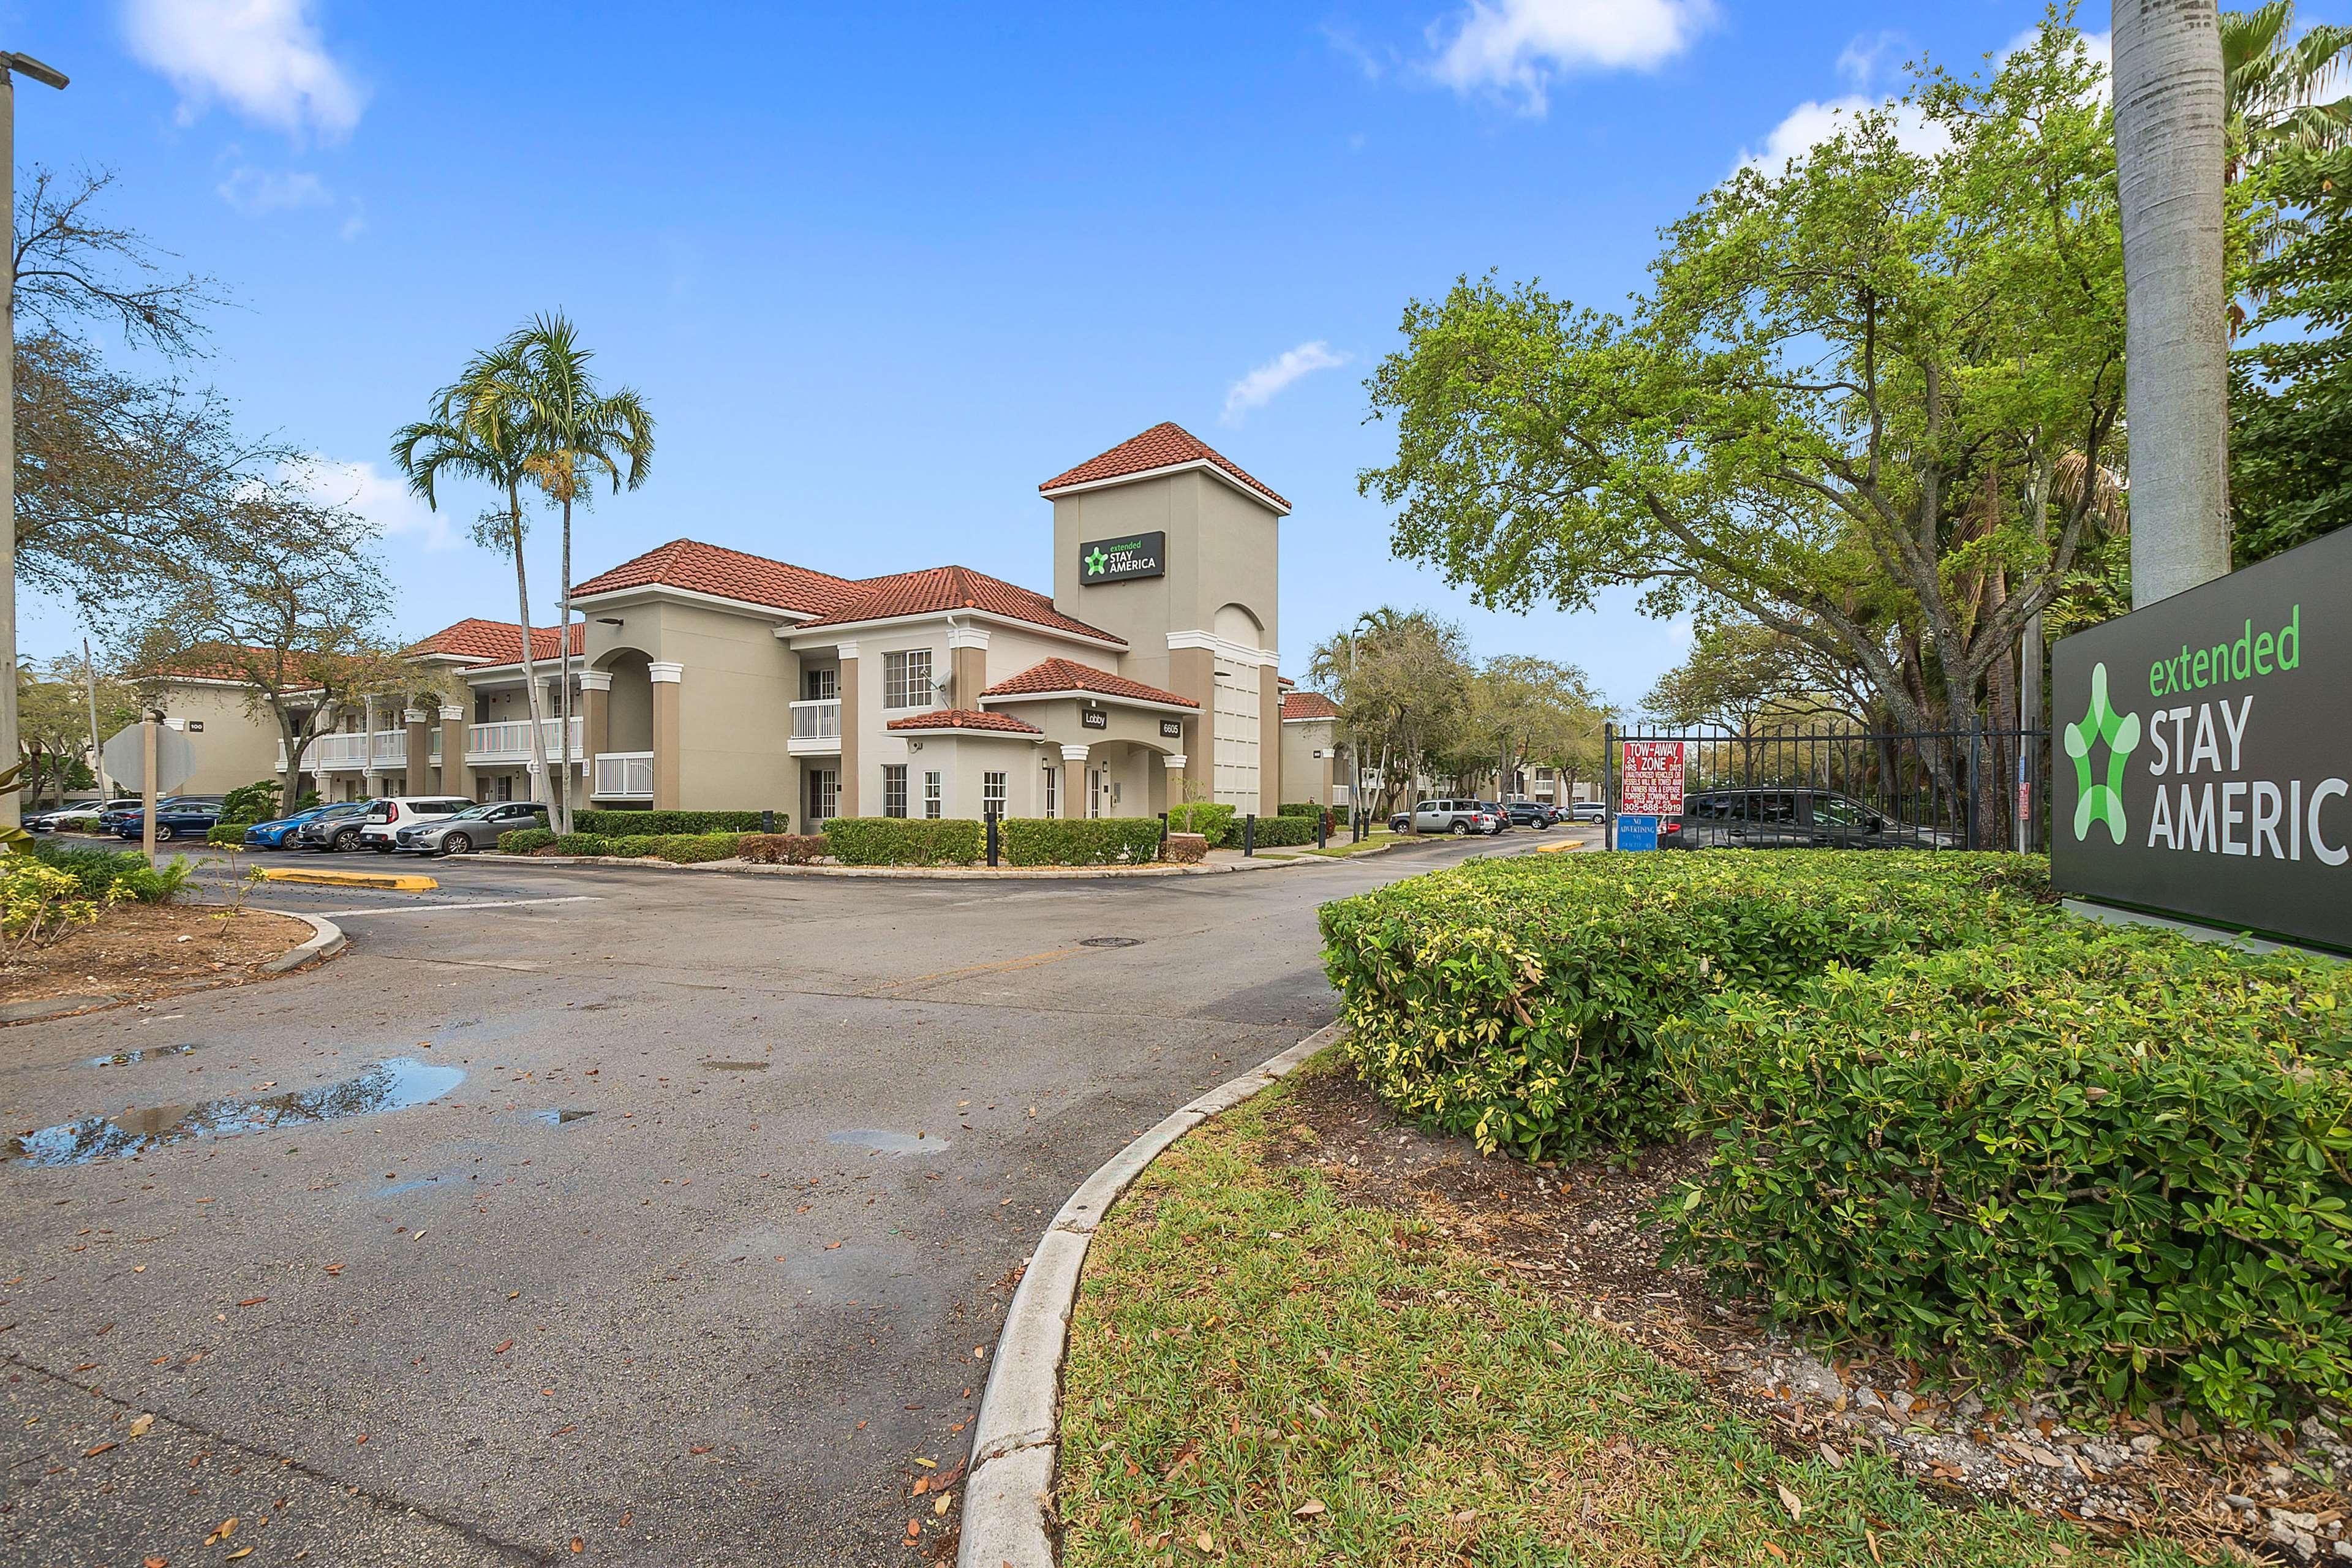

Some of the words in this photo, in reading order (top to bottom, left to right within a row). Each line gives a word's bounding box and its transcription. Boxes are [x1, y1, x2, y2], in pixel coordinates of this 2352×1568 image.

[1110, 540, 1142, 552] extended
[1110, 551, 1133, 563] STAY
[1109, 557, 1156, 573] AMERICA
[2149, 604, 2299, 697] extended
[1086, 712, 1105, 726] Lobby
[1164, 723, 1178, 734] 6605
[2149, 695, 2254, 776] STAY
[1630, 743, 1678, 756] TOW-AWAY
[1641, 757, 1666, 771] ZONE
